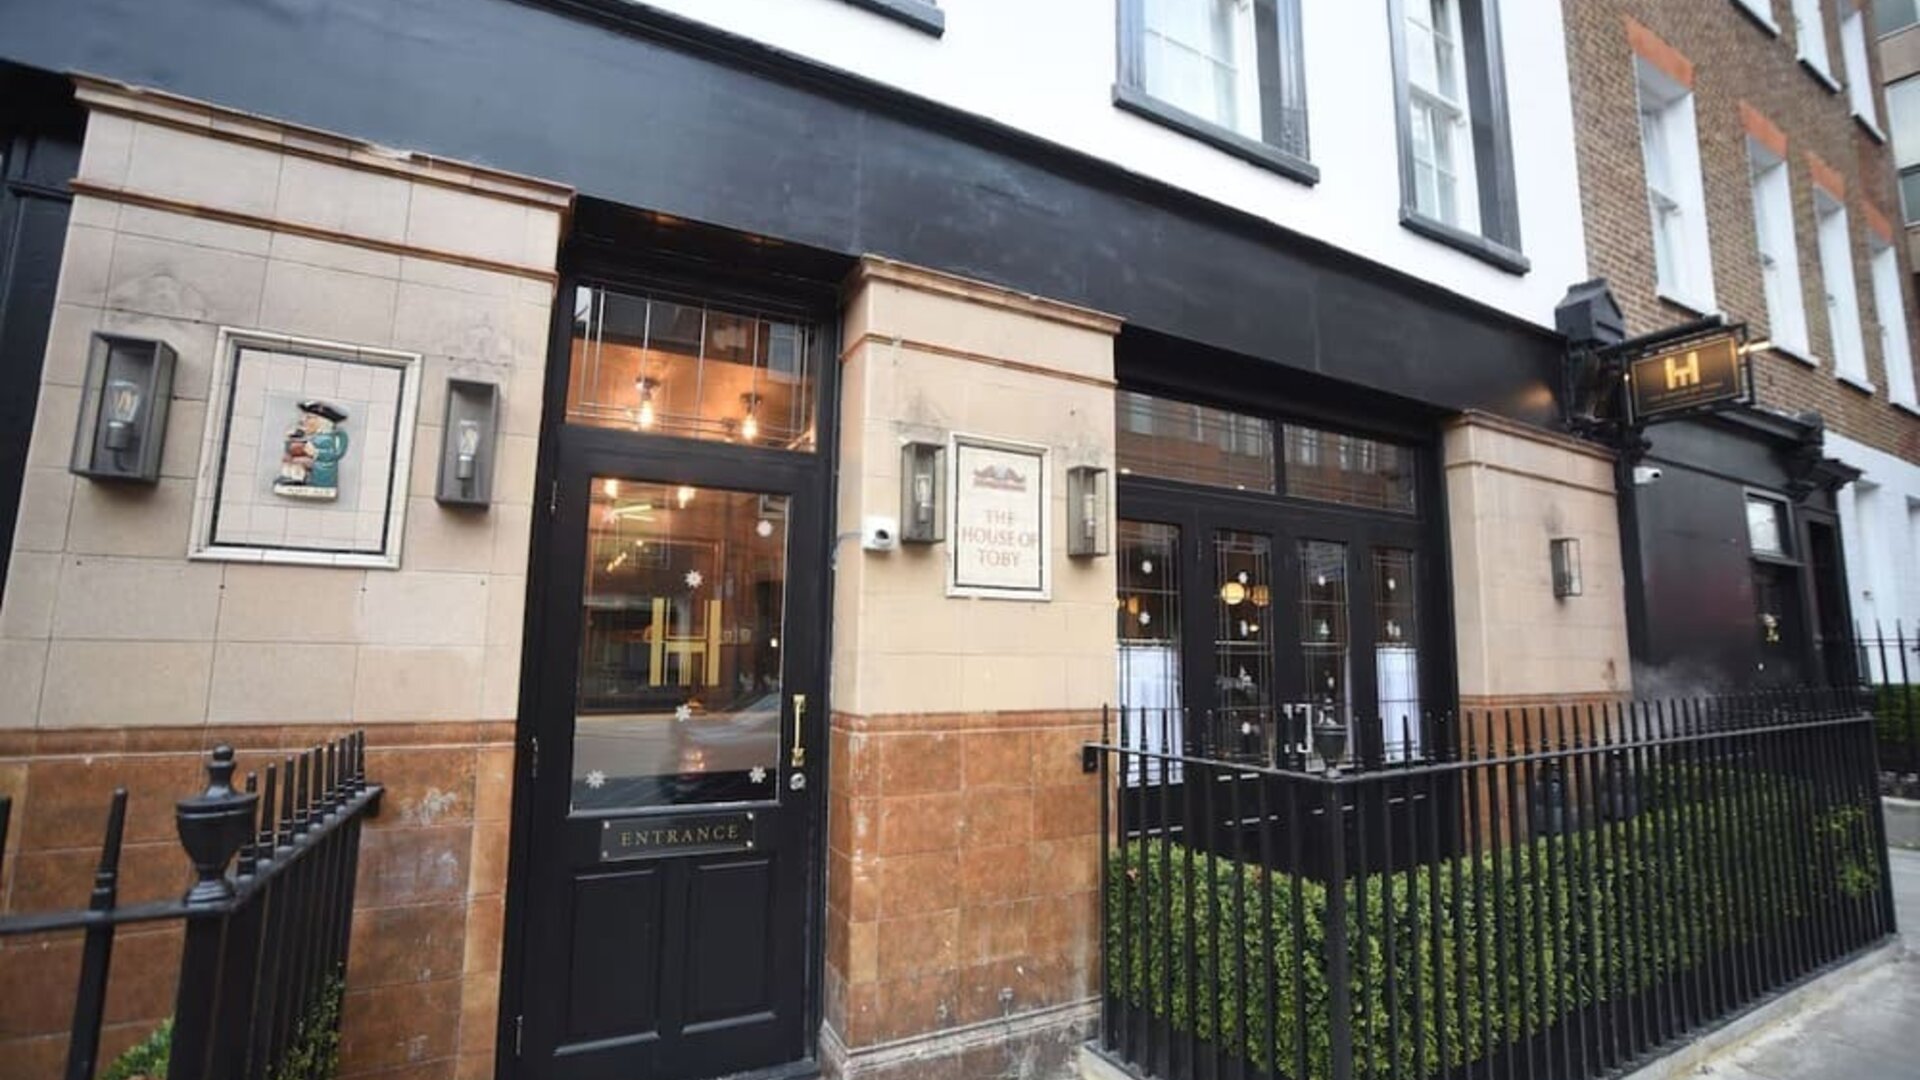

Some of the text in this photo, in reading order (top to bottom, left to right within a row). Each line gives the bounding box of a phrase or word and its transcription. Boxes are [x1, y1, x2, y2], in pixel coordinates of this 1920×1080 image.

[984, 508, 1016, 525] THE
[961, 526, 1038, 549] HOUSE OF
[978, 548, 1021, 567] TOBY
[620, 823, 739, 847] ENTRANCE
